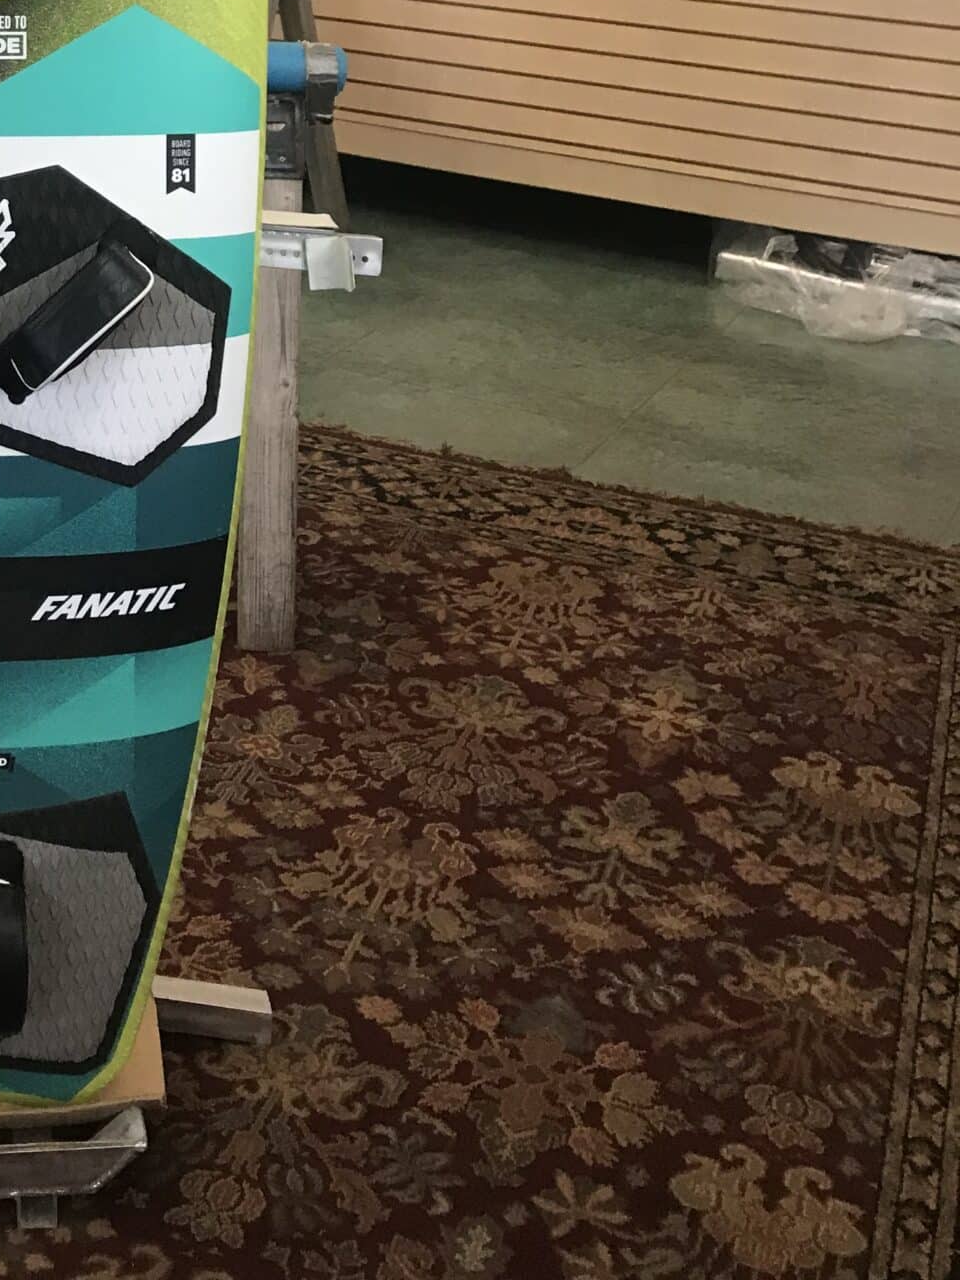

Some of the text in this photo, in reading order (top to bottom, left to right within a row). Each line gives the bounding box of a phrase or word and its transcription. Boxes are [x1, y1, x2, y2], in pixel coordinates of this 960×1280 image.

[15, 15, 27, 29] TO
[171, 167, 190, 183] 81
[31, 583, 186, 621] FANATIC
